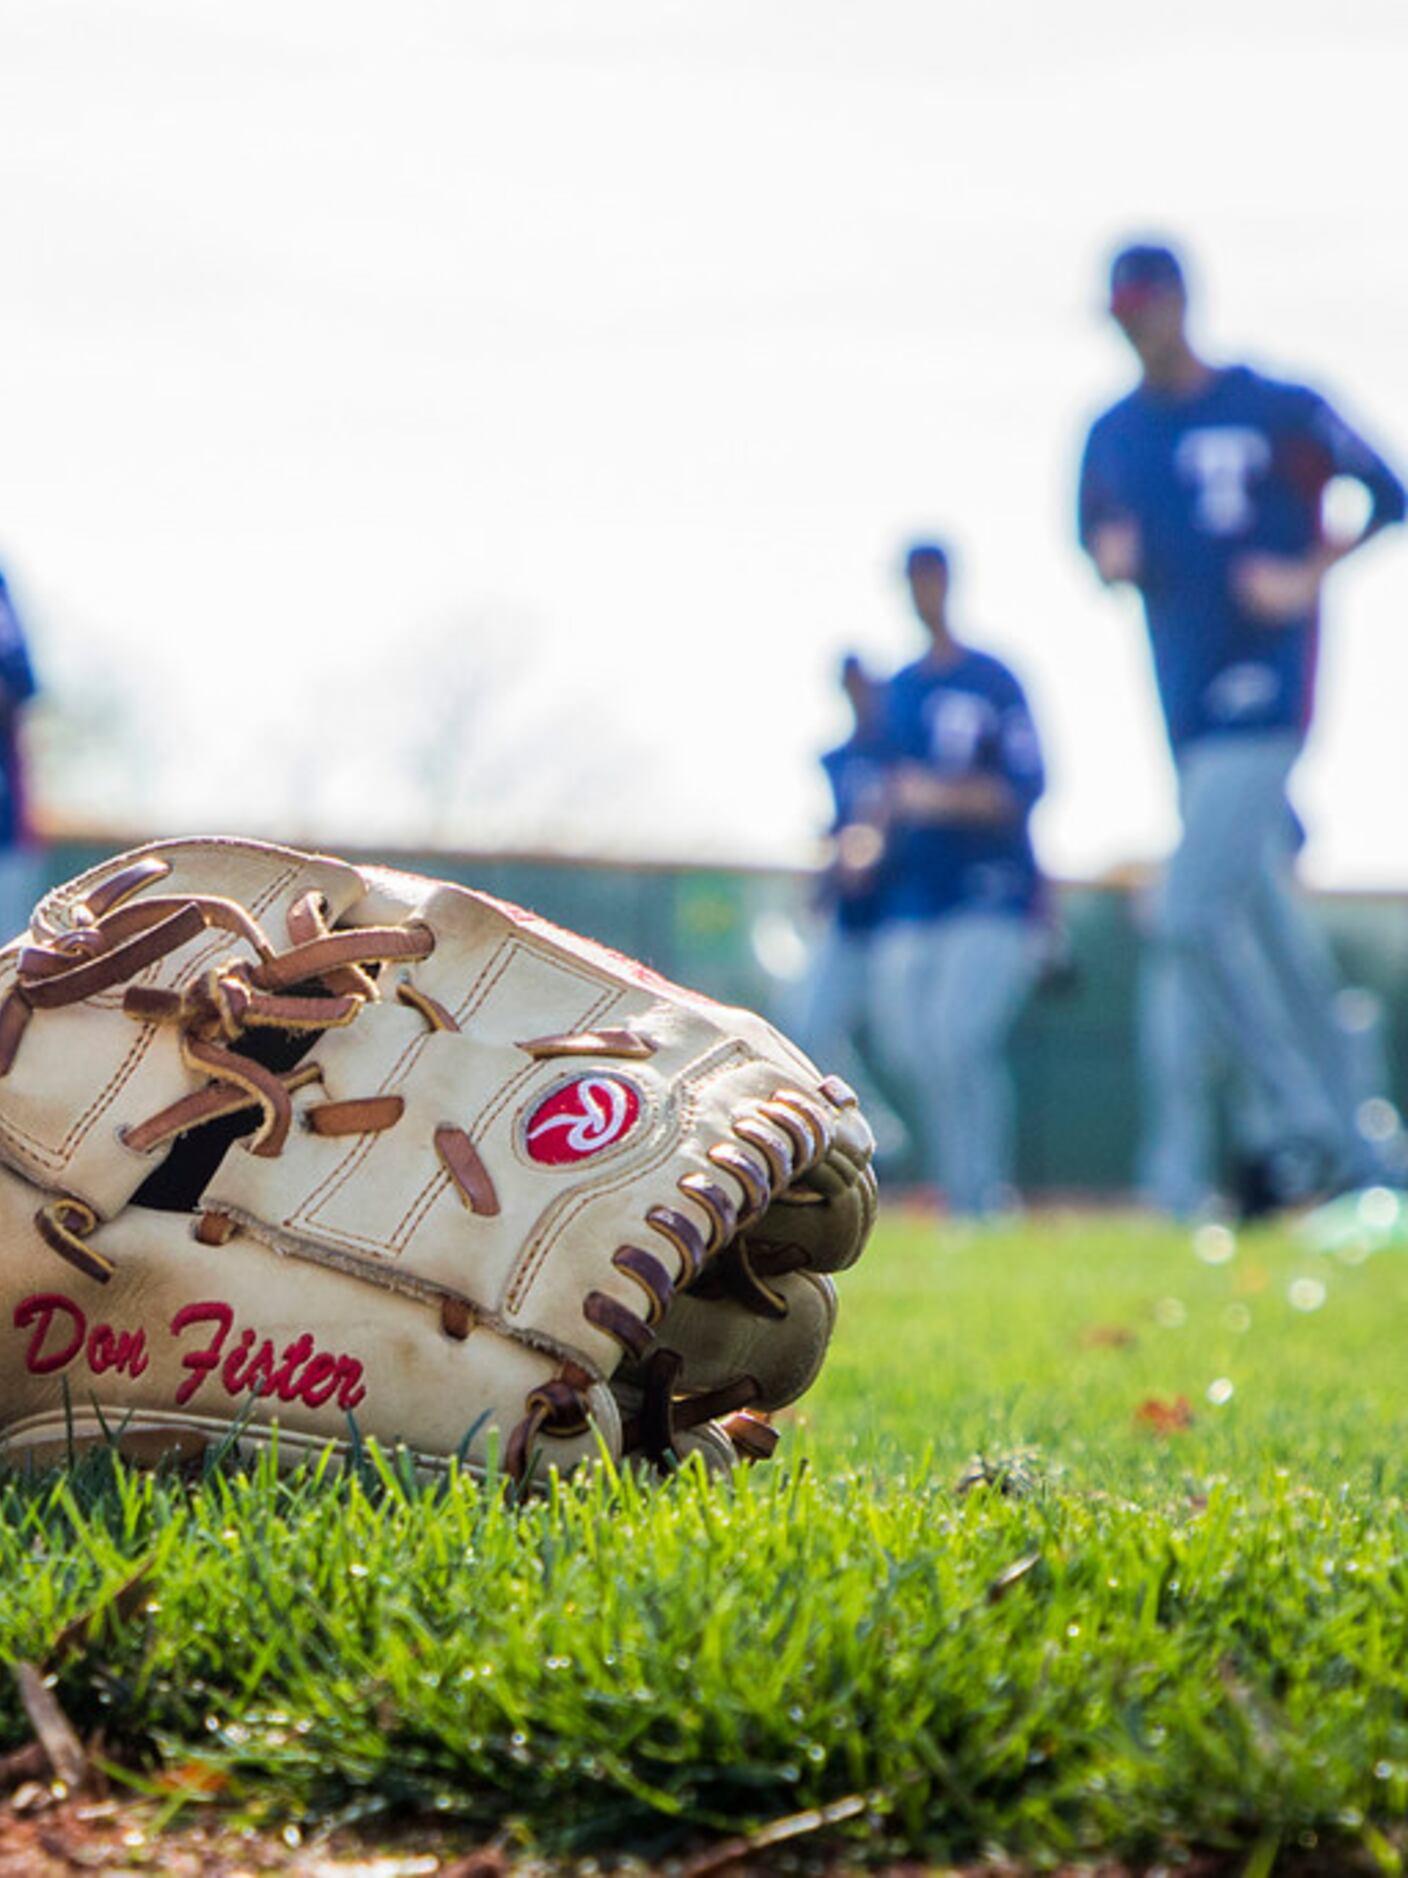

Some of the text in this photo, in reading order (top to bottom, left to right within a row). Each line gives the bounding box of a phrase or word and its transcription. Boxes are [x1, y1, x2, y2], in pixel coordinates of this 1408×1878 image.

[1176, 424, 1270, 535] T
[528, 1078, 628, 1150] R
[13, 1293, 366, 1411] Don Fister
